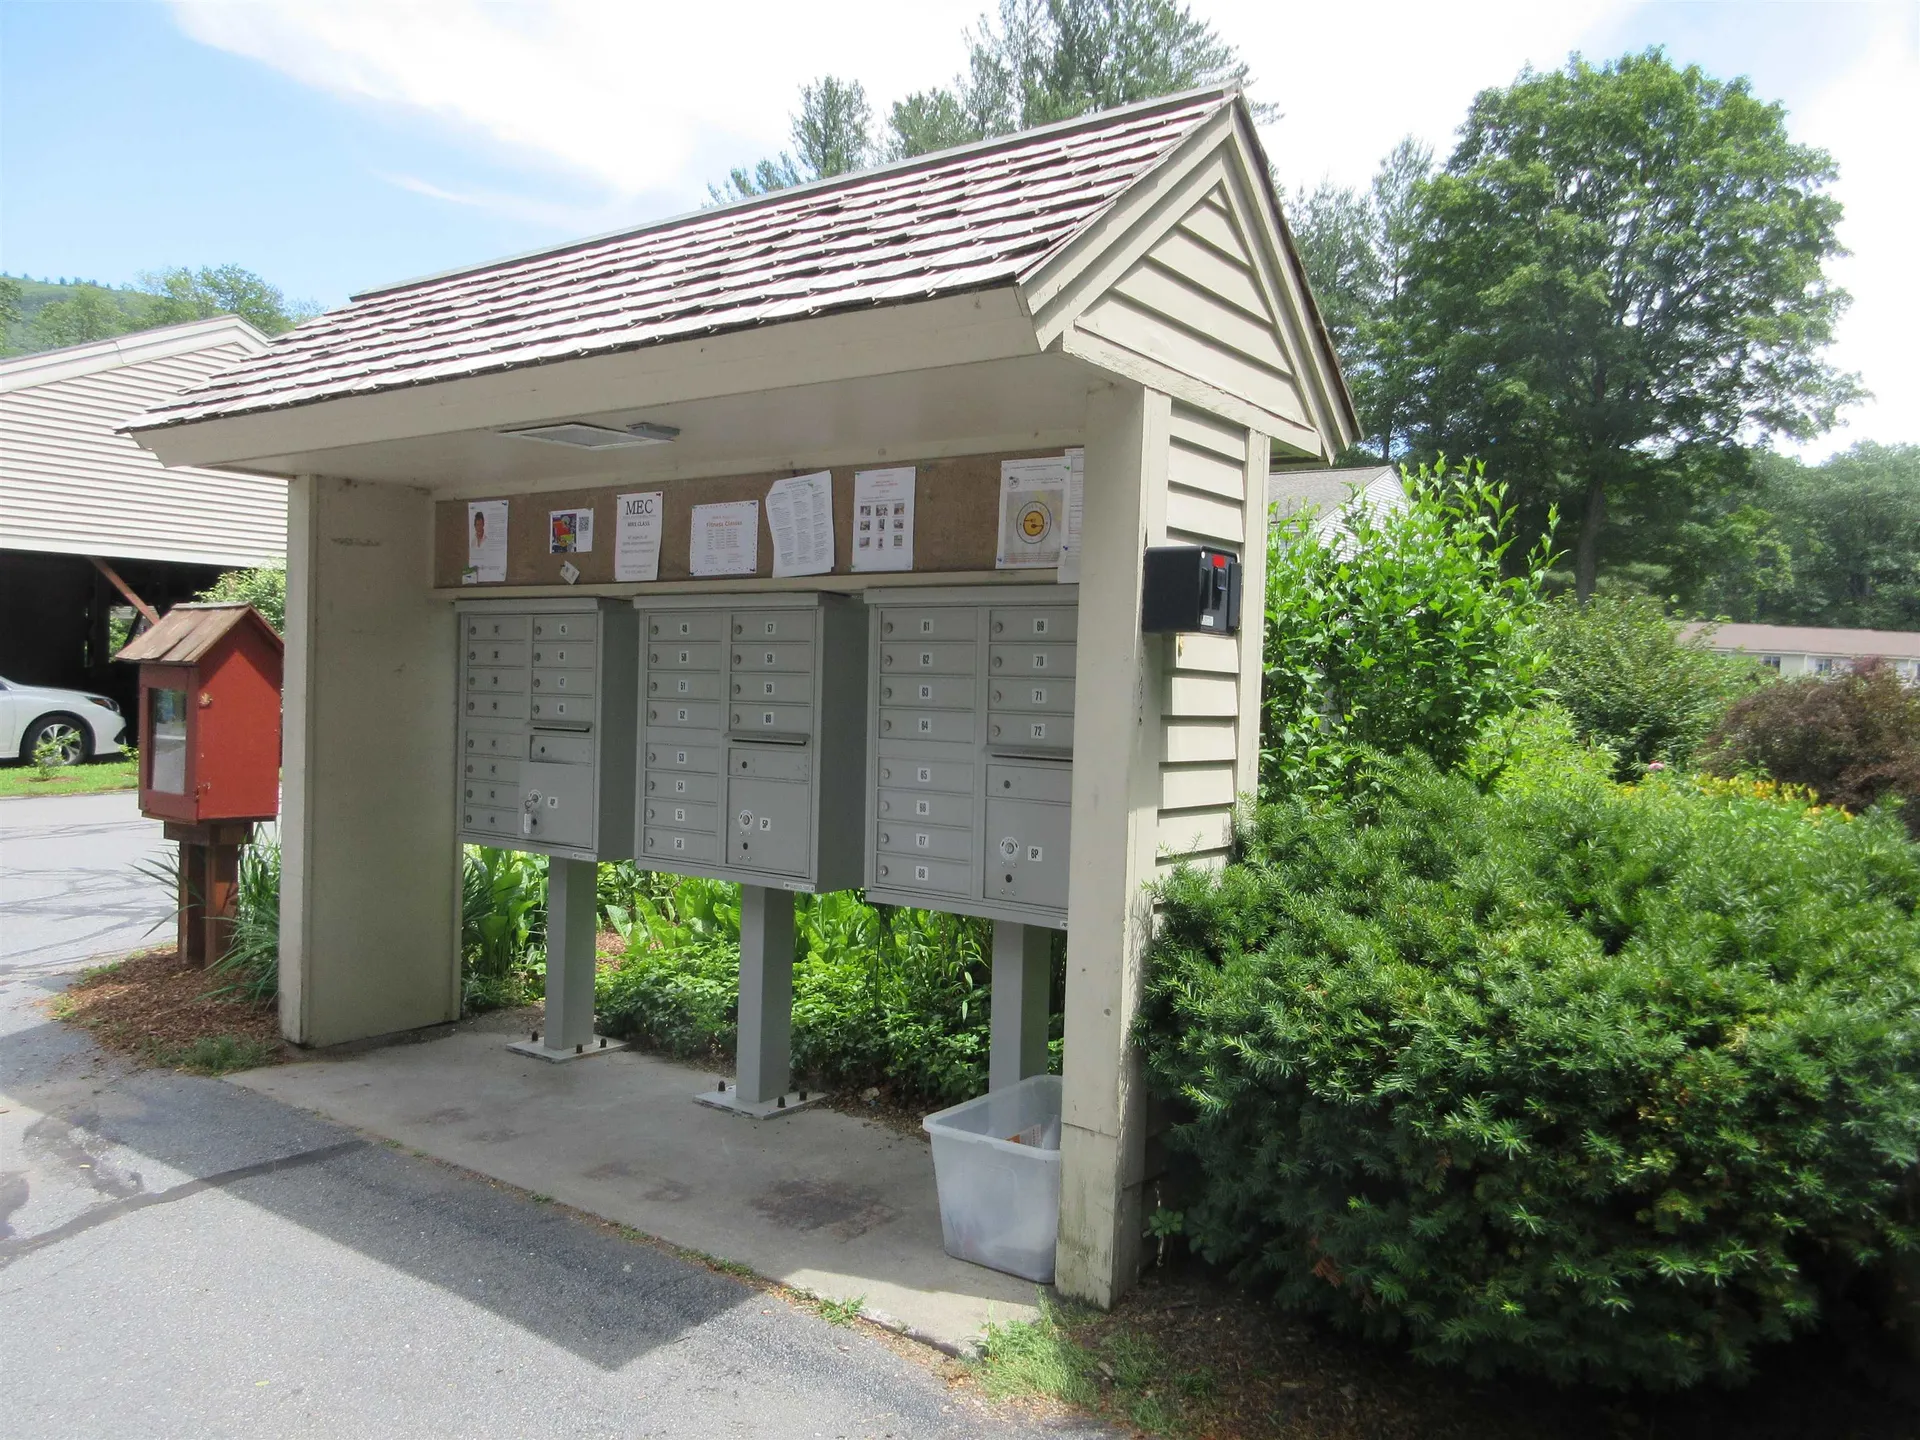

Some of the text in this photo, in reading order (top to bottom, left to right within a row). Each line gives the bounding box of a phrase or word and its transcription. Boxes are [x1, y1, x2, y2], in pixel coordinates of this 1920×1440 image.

[626, 499, 653, 515] MEC
[767, 623, 774, 633] 57
[923, 621, 930, 631] 61
[1036, 620, 1044, 632] 69
[922, 654, 930, 665] 62
[1036, 656, 1044, 667] 70
[680, 681, 686, 690] 51
[921, 687, 929, 697] 63
[1035, 690, 1042, 701] 71
[679, 710, 686, 719] 52
[921, 720, 928, 731] 64
[1034, 726, 1042, 736] 72
[920, 770, 928, 780] 65
[678, 782, 683, 791] 54
[677, 810, 683, 820] 55
[762, 819, 768, 829] 5P
[918, 836, 926, 846] 67
[1030, 848, 1039, 859] 6P
[918, 868, 926, 879] 68
